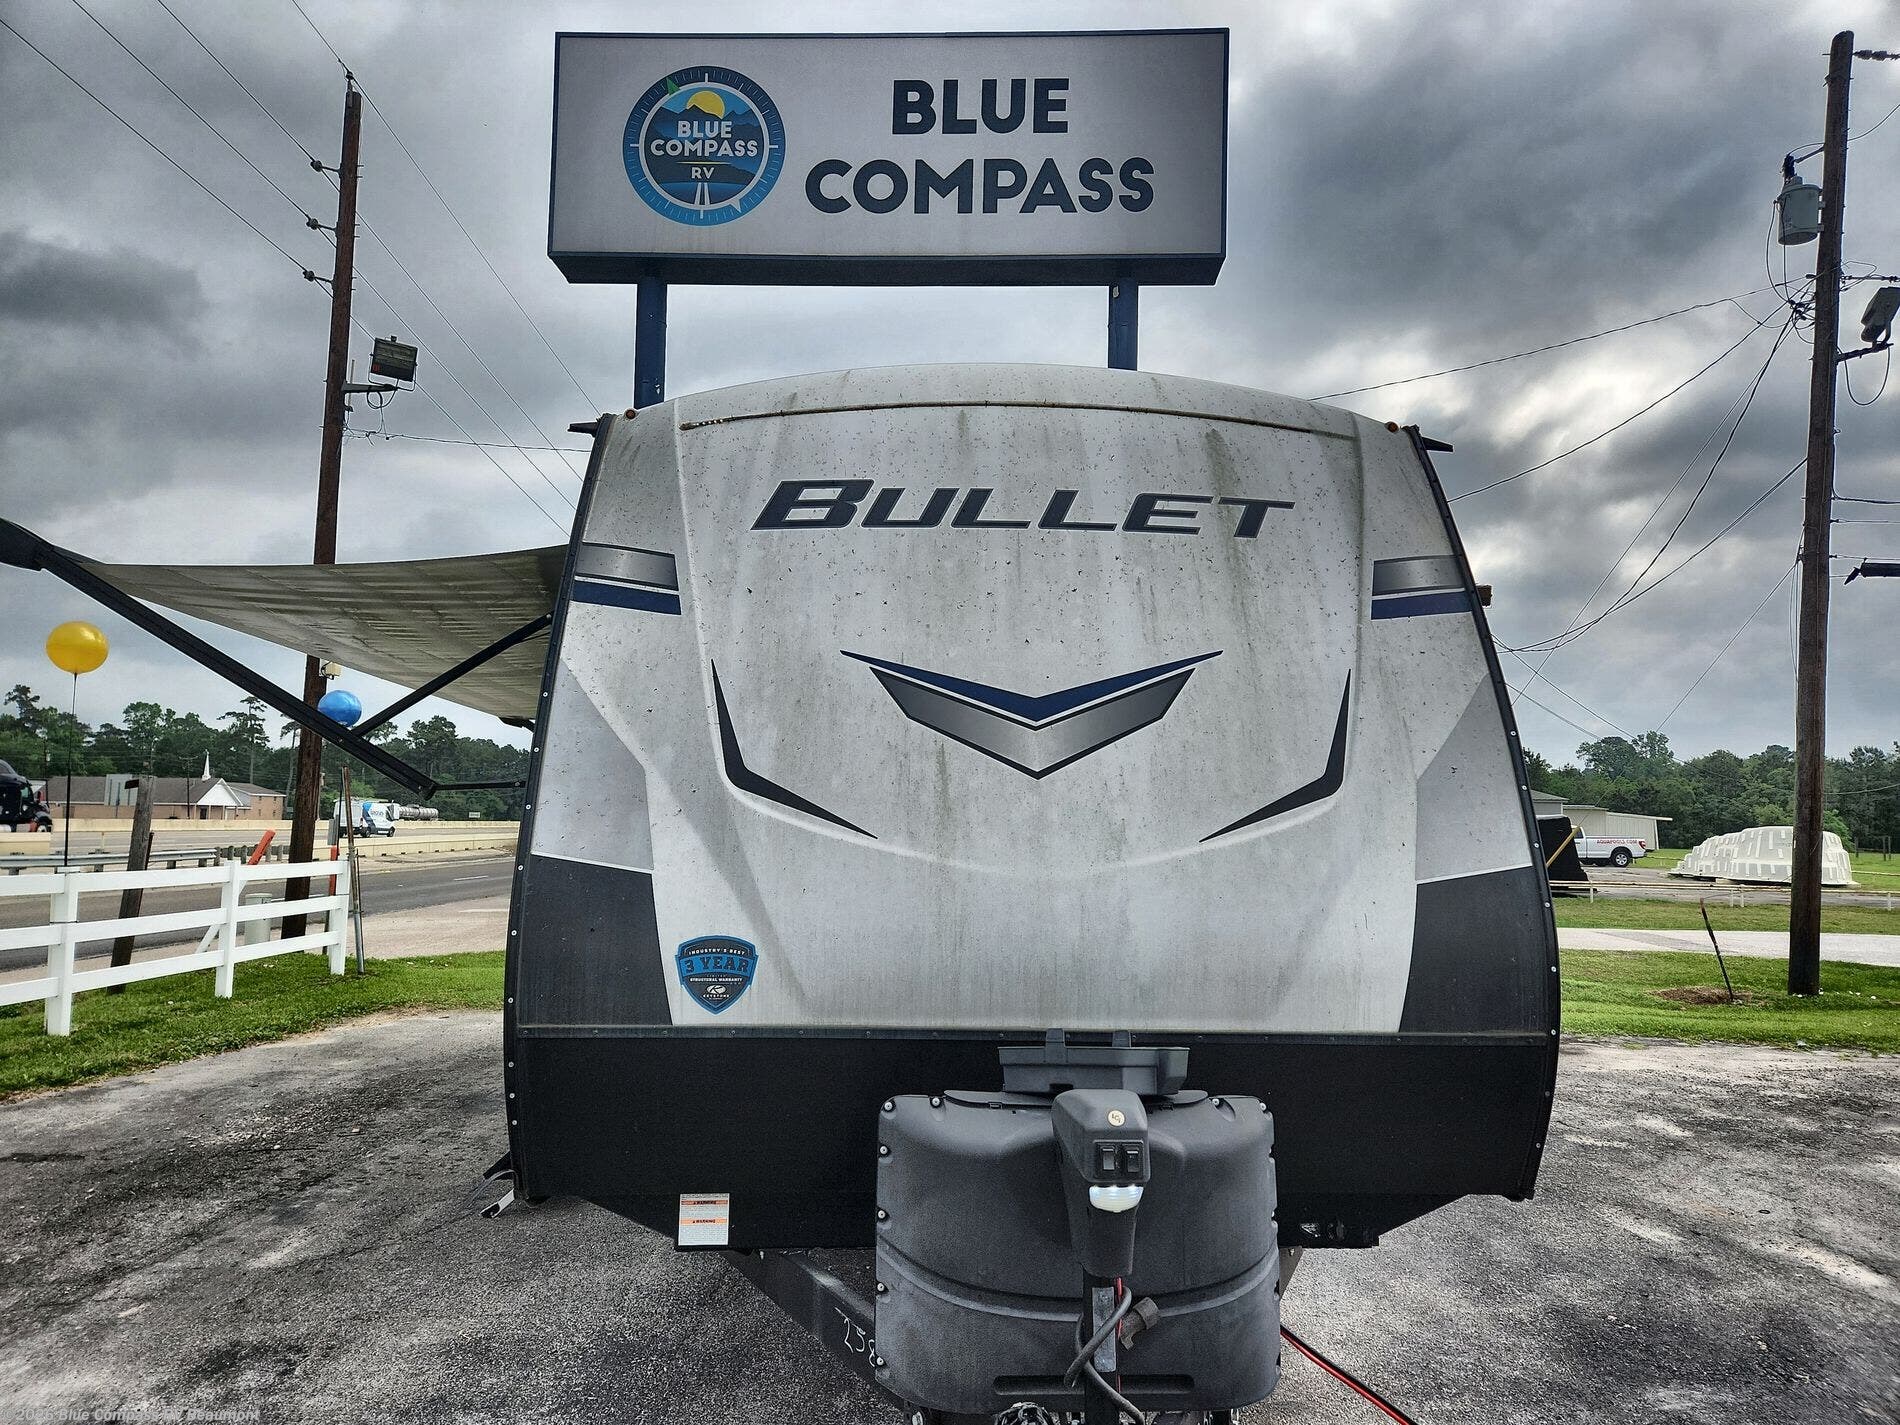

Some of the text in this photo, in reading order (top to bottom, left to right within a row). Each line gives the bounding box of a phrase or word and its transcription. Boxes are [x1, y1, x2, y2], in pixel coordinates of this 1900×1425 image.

[892, 78, 1070, 135] BLUE
[677, 120, 733, 139] BLUE
[650, 139, 758, 157] COMPASS
[691, 166, 715, 179] RV
[804, 156, 1155, 215] COMPASS
[750, 478, 1296, 539] BULLET
[684, 956, 749, 973] 3 YEAR
